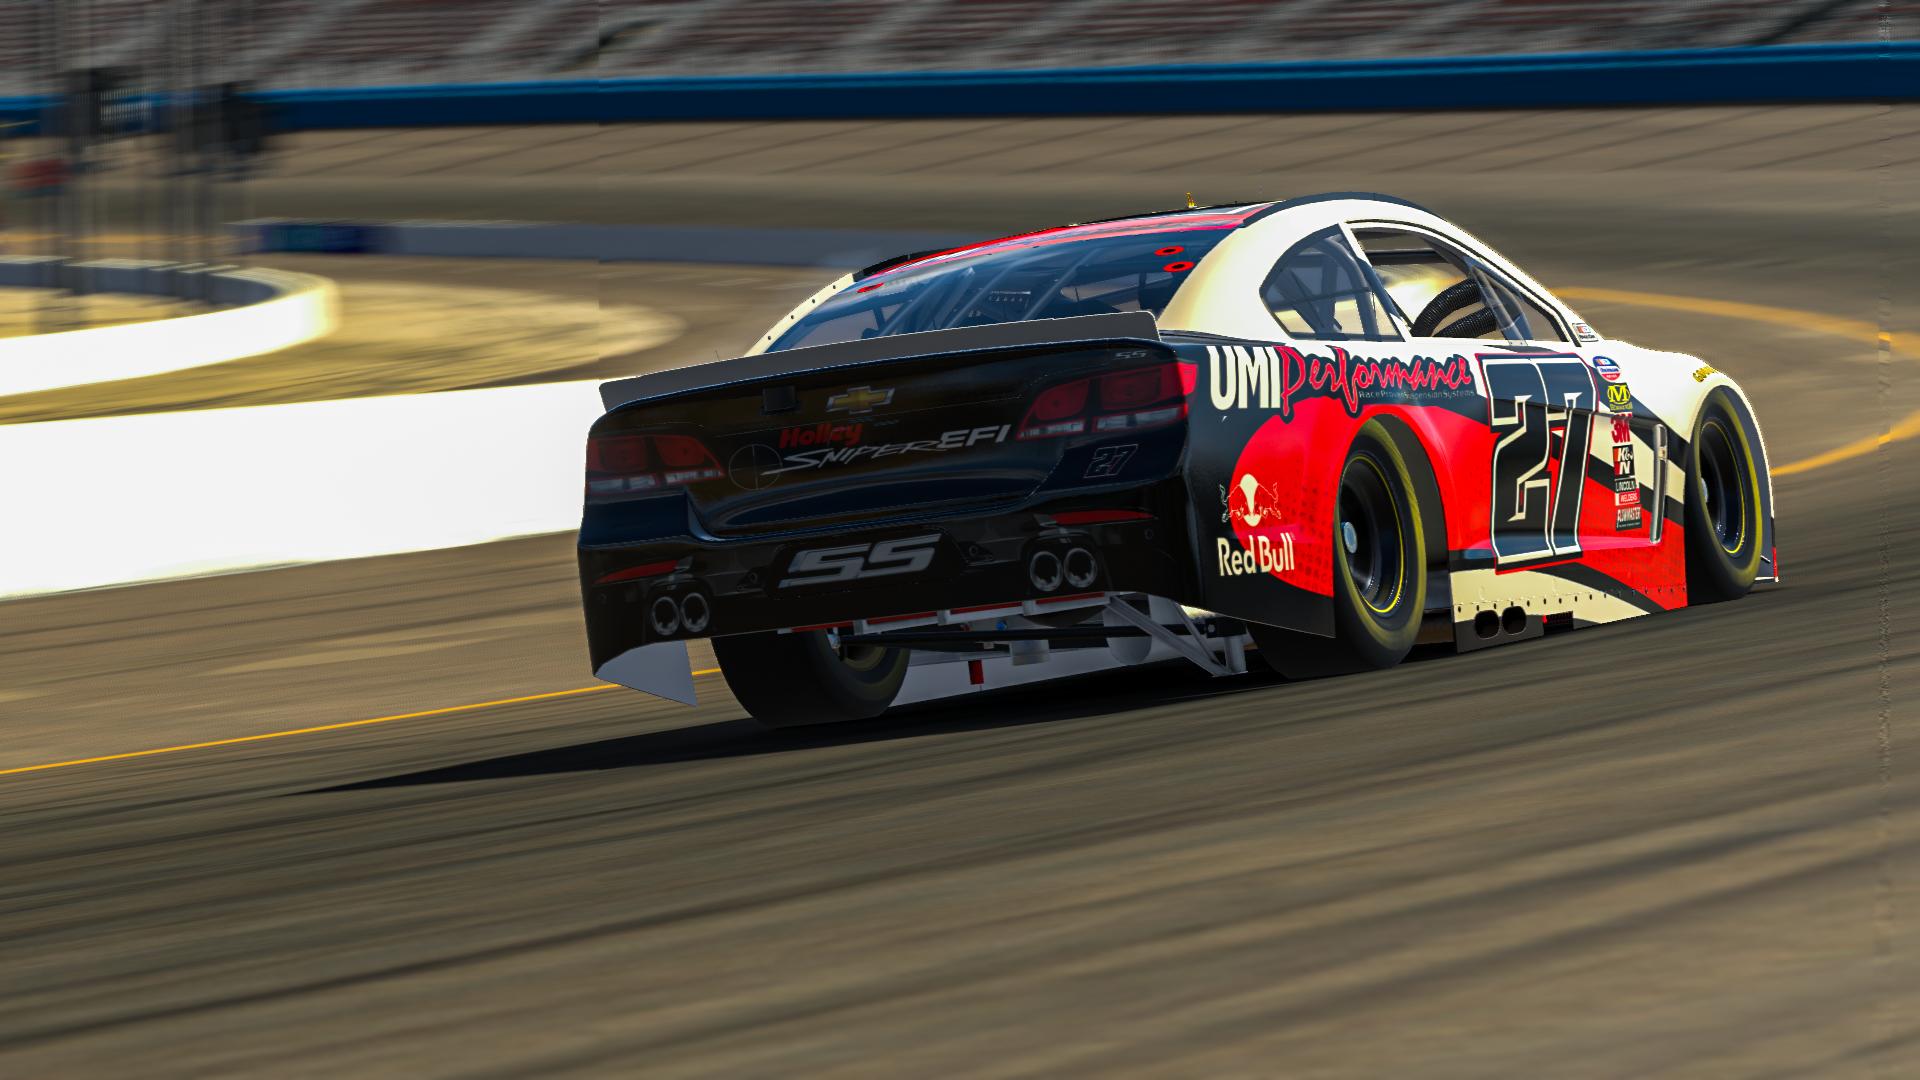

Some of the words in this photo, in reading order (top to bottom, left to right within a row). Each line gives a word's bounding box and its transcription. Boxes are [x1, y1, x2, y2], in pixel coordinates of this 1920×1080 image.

[1207, 345, 1280, 411] UMI
[1272, 344, 1472, 417] Performance
[779, 423, 864, 448] Holley
[936, 424, 1012, 449] EFI
[1610, 413, 1632, 443] 3M
[1083, 443, 1139, 478] 27
[1480, 356, 1597, 565] 27
[777, 533, 942, 589] SS
[1217, 535, 1257, 576] Red
[1257, 532, 1295, 573] Bull
